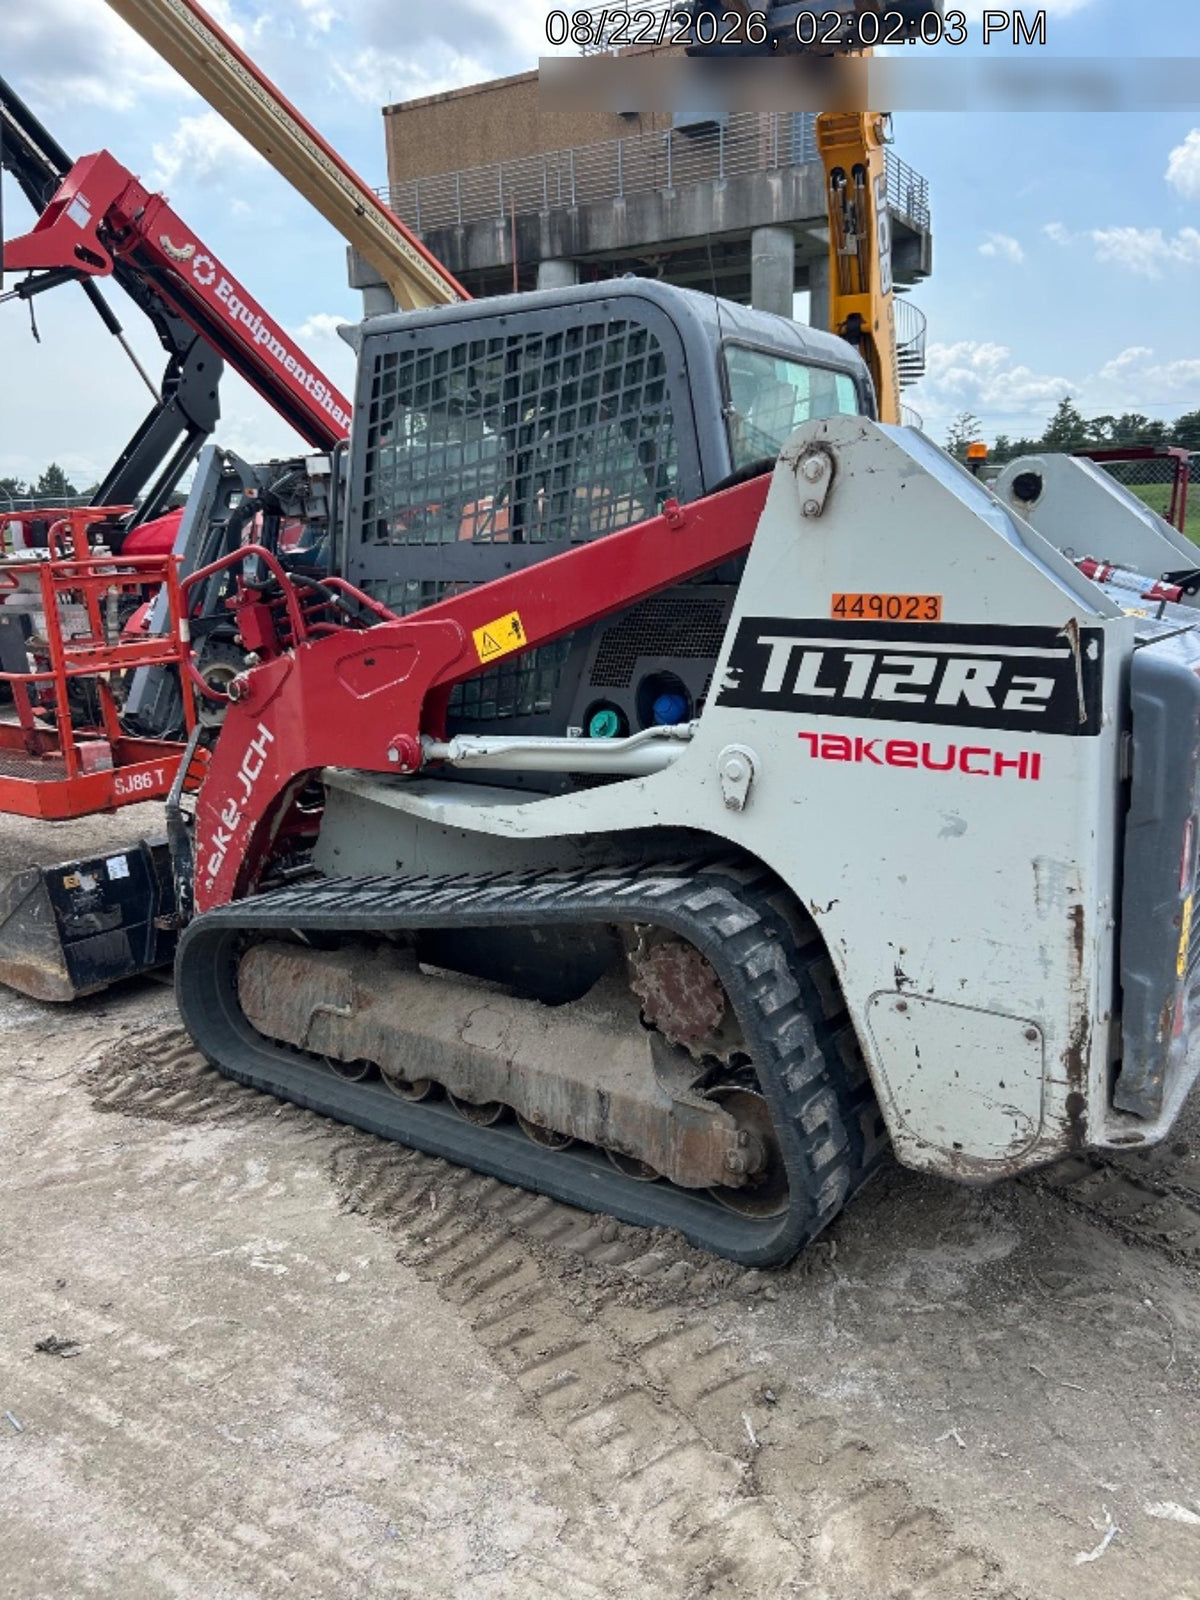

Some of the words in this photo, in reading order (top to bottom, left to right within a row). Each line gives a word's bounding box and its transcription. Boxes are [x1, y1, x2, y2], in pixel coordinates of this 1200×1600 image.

[213, 275, 352, 437] EquipmentShar
[833, 595, 939, 620] 449023
[154, 768, 166, 786] T
